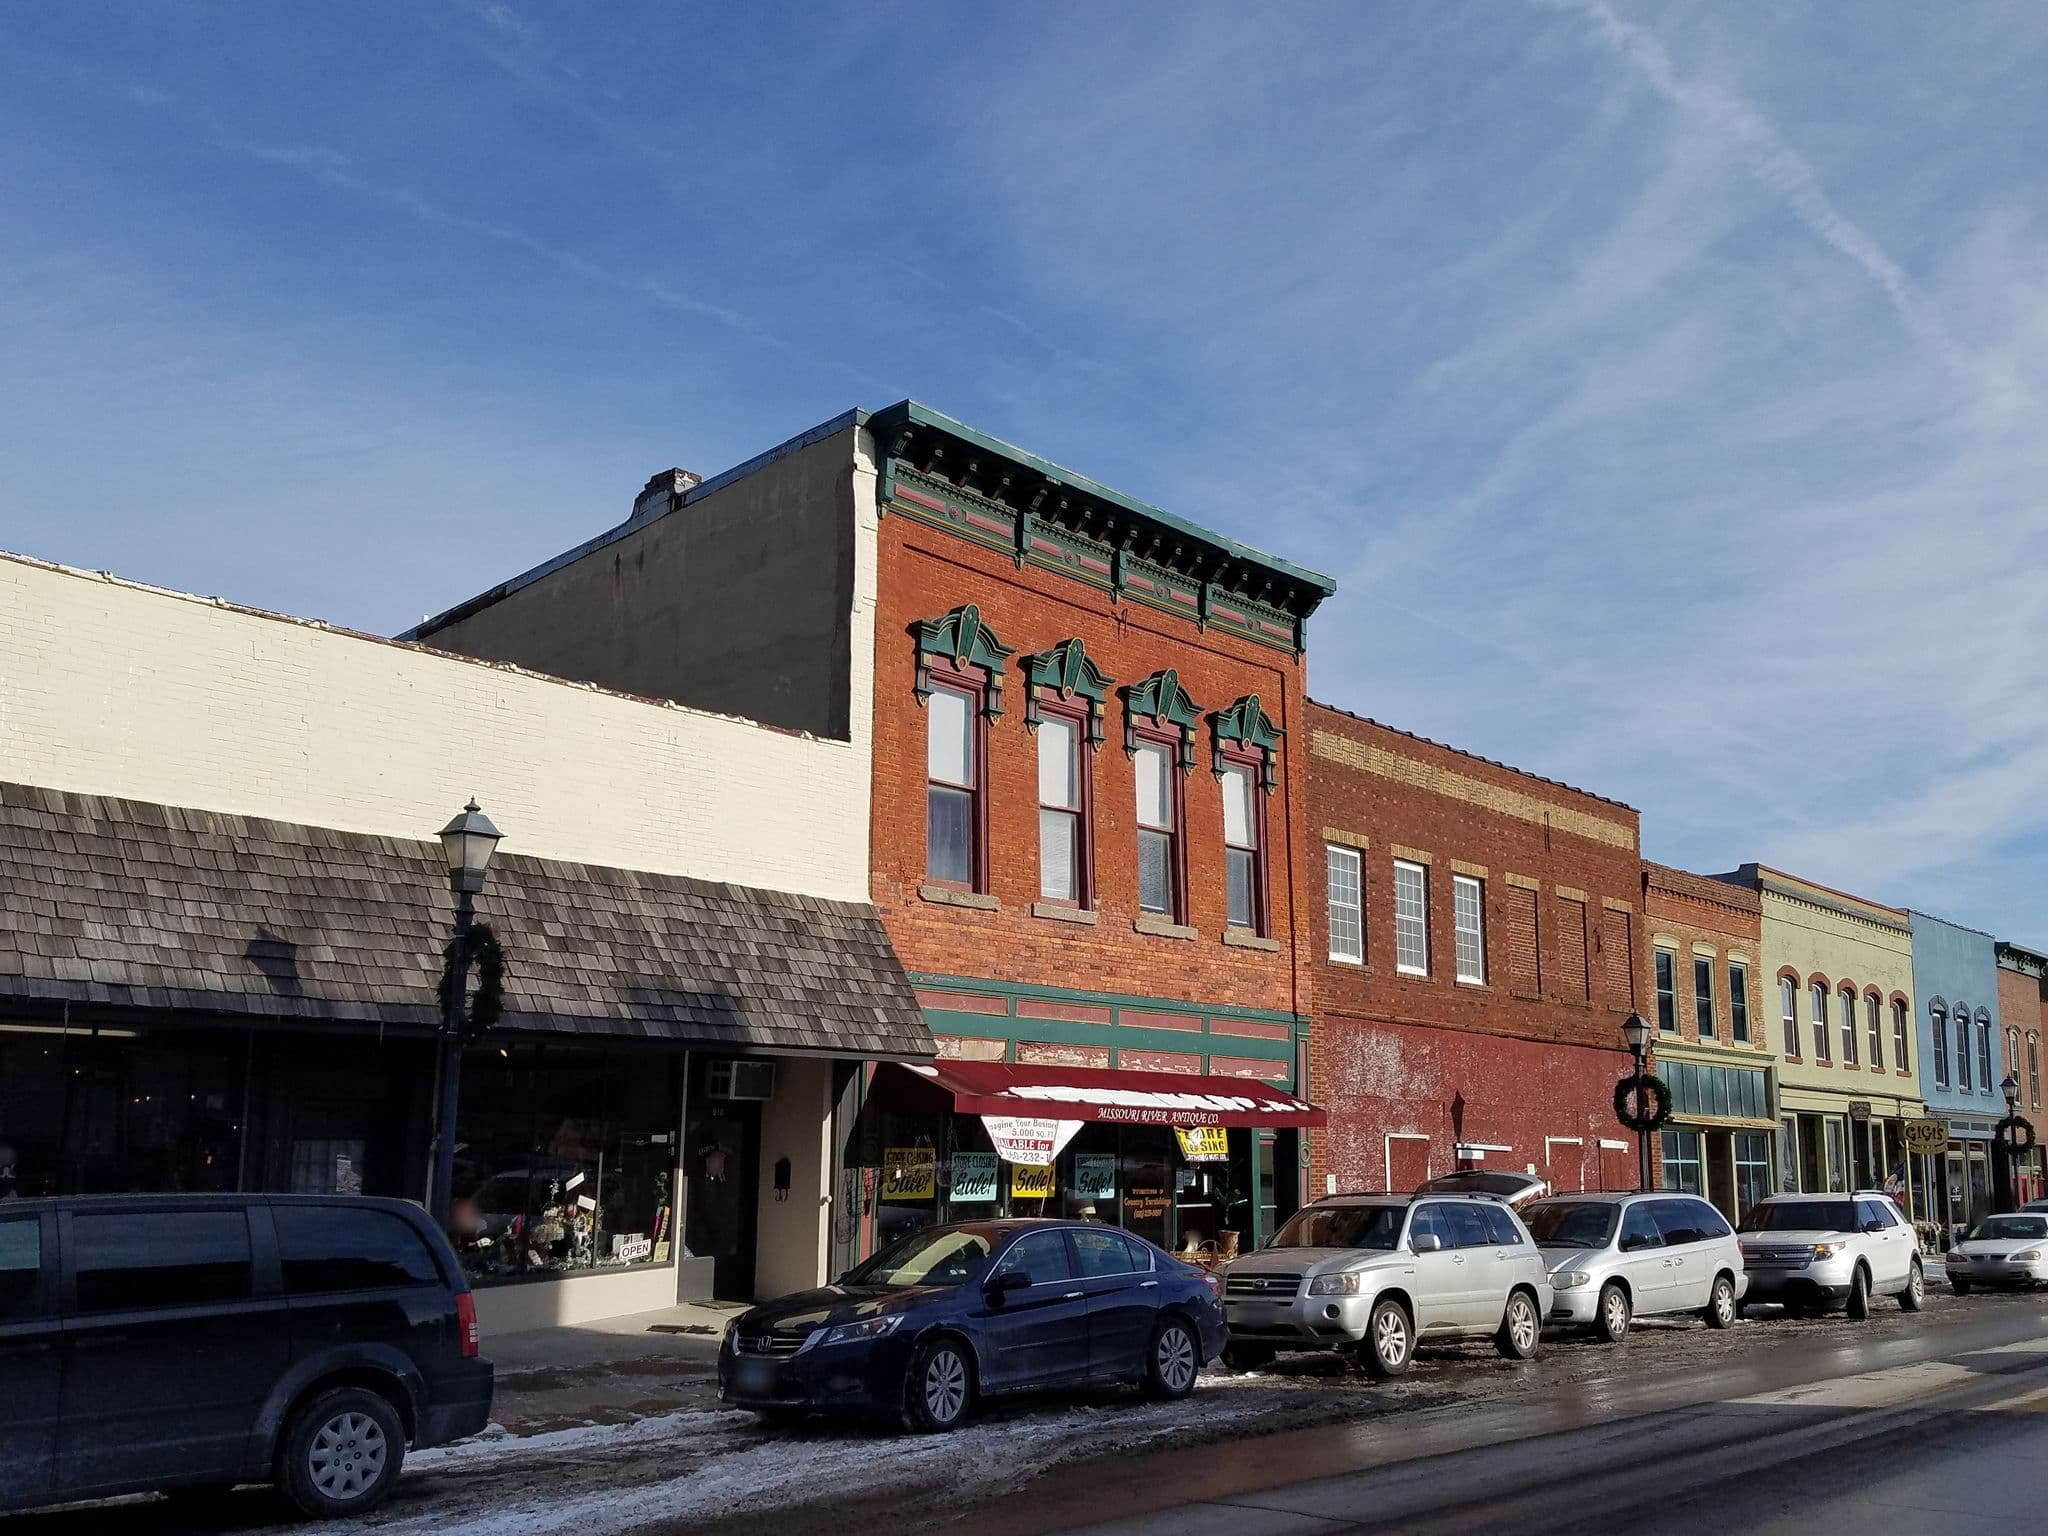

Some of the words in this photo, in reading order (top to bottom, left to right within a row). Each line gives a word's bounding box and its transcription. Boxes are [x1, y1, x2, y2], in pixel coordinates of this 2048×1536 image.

[1098, 1107, 1139, 1121] MISSOURI
[1141, 1109, 1169, 1123] RIVER
[1169, 1111, 1207, 1125] ANTIQUE
[1207, 1113, 1219, 1124] CO.
[955, 1172, 995, 1196] Sale!
[1015, 1168, 1053, 1192] Sale!
[1079, 1171, 1113, 1194] Sale!
[622, 1243, 649, 1257] OPEN
